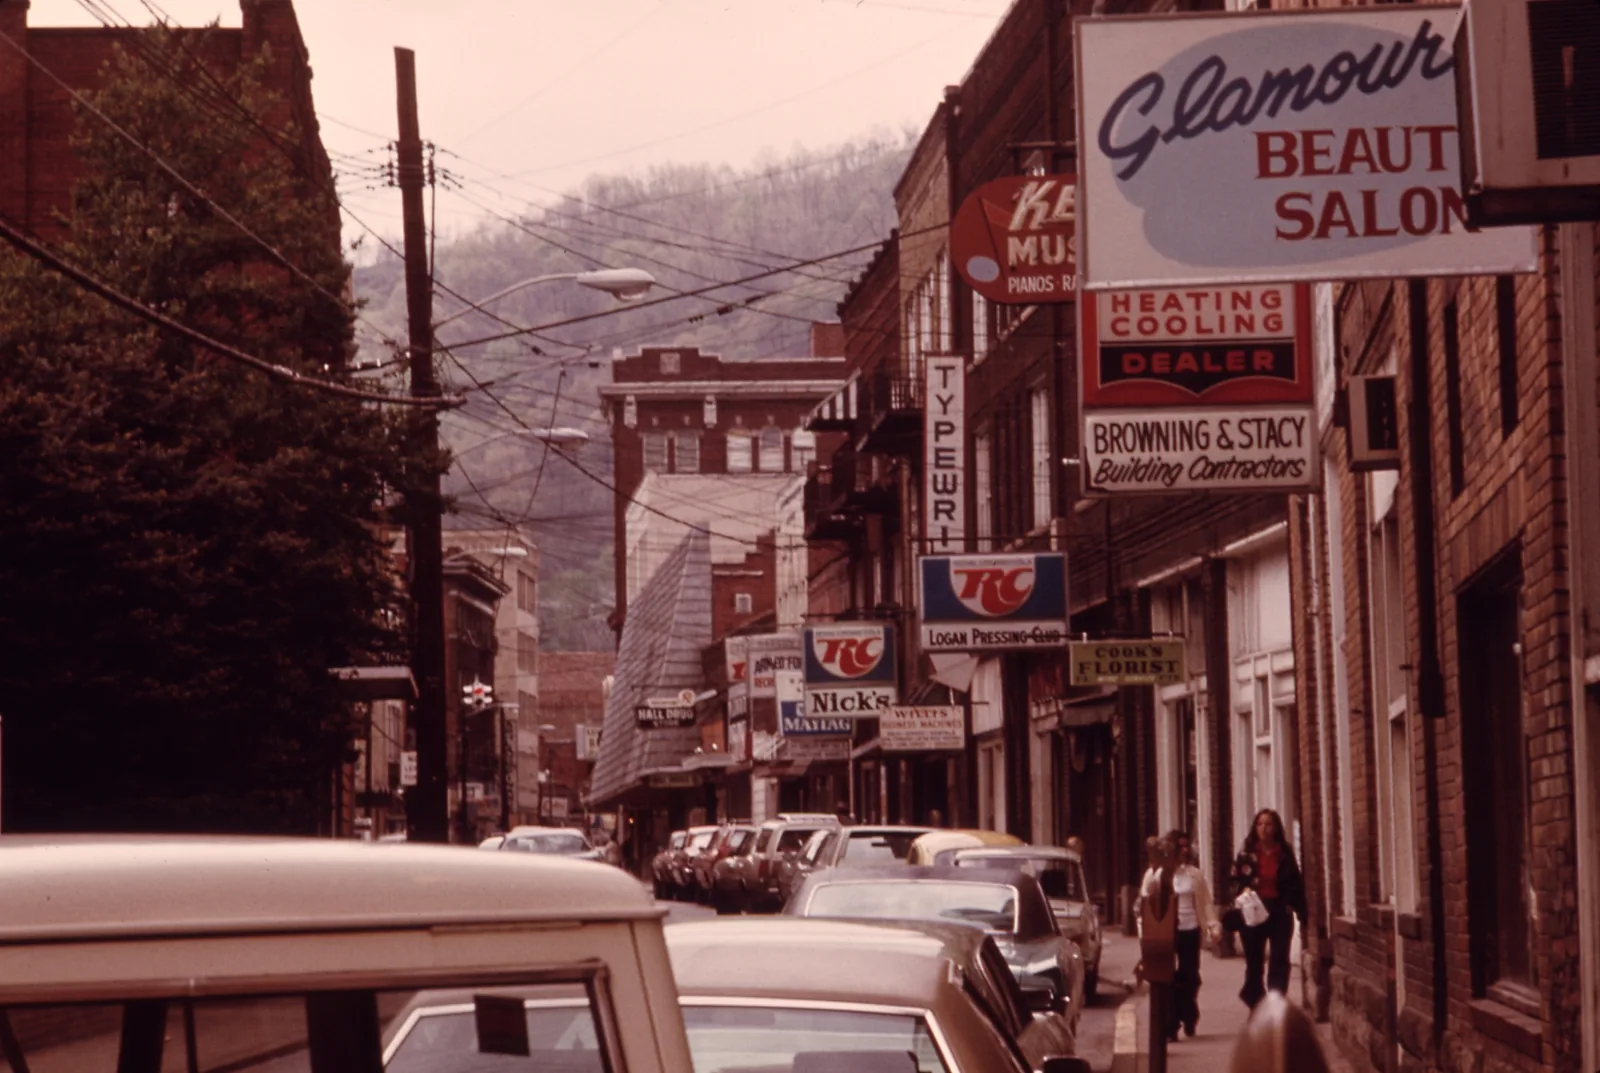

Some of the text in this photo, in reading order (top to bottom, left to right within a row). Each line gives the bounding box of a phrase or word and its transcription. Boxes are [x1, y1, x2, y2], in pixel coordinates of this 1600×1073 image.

[1098, 20, 1454, 181] Glamour
[1007, 275, 1054, 293] PIANOS
[1111, 289, 1283, 313] HEATING
[1110, 313, 1284, 337] COOLING
[1122, 350, 1275, 374] DEALER
[1093, 416, 1306, 454] BROWNING & STACY
[1093, 453, 1307, 487] Building Contractors
[953, 567, 1033, 614] RC
[929, 629, 968, 646] LOGAN
[972, 627, 1028, 645] PRESSING
[816, 636, 882, 676] RC
[1095, 644, 1163, 659] COOK'S
[1078, 660, 1180, 674] FLORIST
[811, 690, 890, 713] Nick's
